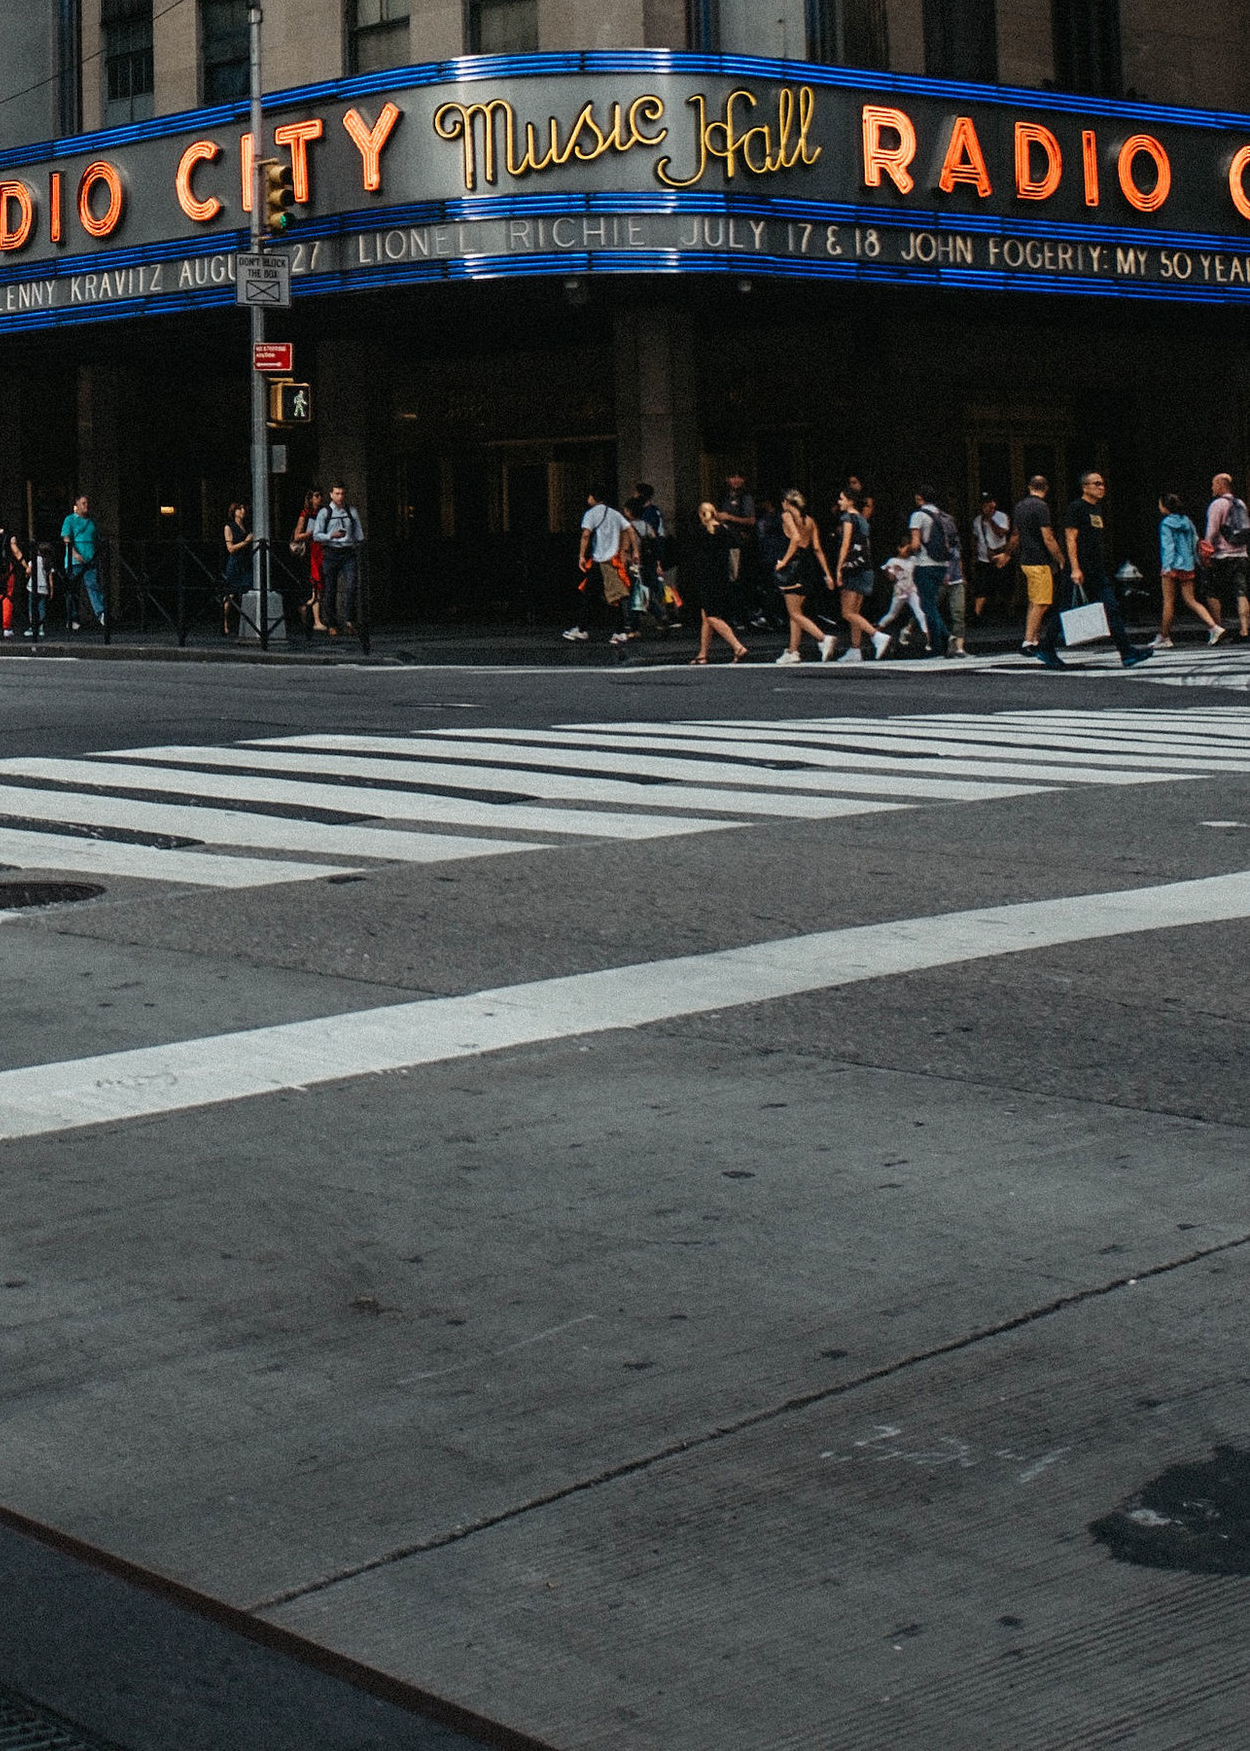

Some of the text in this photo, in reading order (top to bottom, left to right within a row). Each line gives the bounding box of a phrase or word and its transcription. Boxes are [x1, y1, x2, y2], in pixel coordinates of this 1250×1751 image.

[175, 101, 401, 222] CITY
[434, 95, 668, 189] Music
[657, 86, 822, 187] Hall
[862, 104, 1172, 213] RADIO
[70, 264, 163, 302] KRAVITZ
[291, 241, 320, 273] 27
[358, 220, 476, 264] LIONEL
[509, 217, 647, 250] RICHIE
[680, 217, 766, 250] JULY
[788, 222, 812, 251] 17
[855, 228, 881, 257] 18
[901, 232, 973, 265] JOHN
[988, 237, 1109, 274] FOGERTY:
[1116, 247, 1148, 275] MY
[1160, 251, 1192, 280] 50
[262, 258, 286, 268] BLOCK
